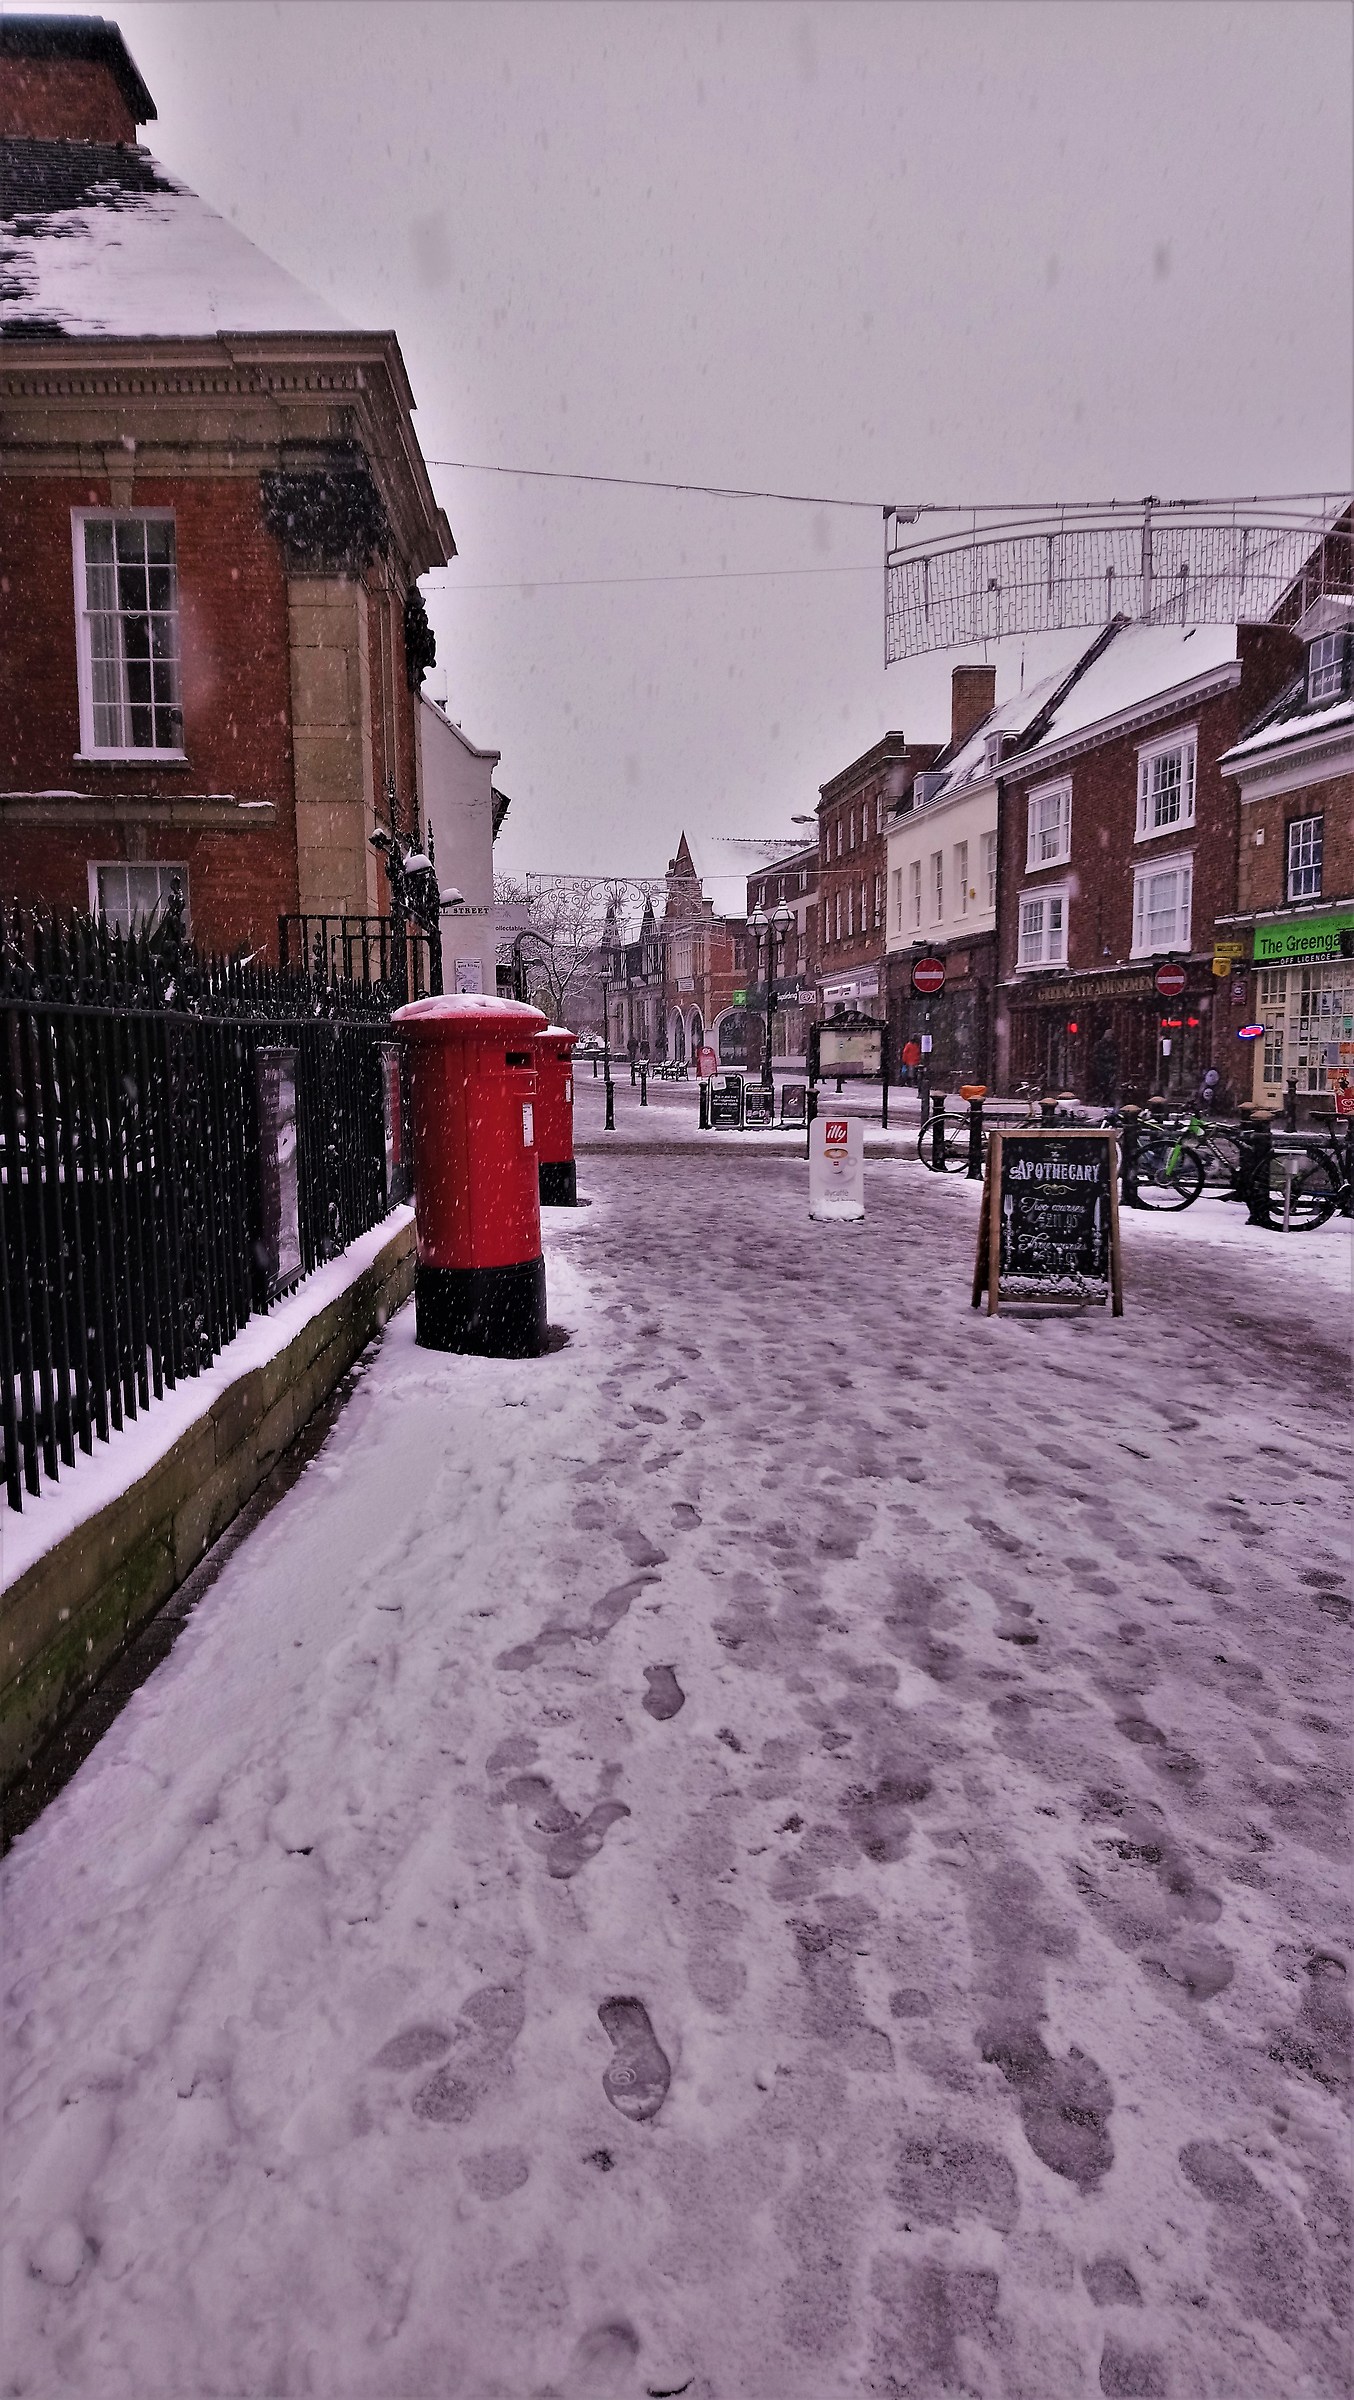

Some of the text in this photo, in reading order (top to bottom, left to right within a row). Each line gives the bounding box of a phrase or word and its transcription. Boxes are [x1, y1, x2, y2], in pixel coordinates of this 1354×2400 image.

[1260, 939, 1283, 955] The
[1297, 953, 1331, 963] LICENCE
[827, 1125, 847, 1142] illy
[1009, 1159, 1101, 1183] APOTHECARY
[1021, 1196, 1087, 1214] Two courses
[1018, 1232, 1052, 1251] Three
